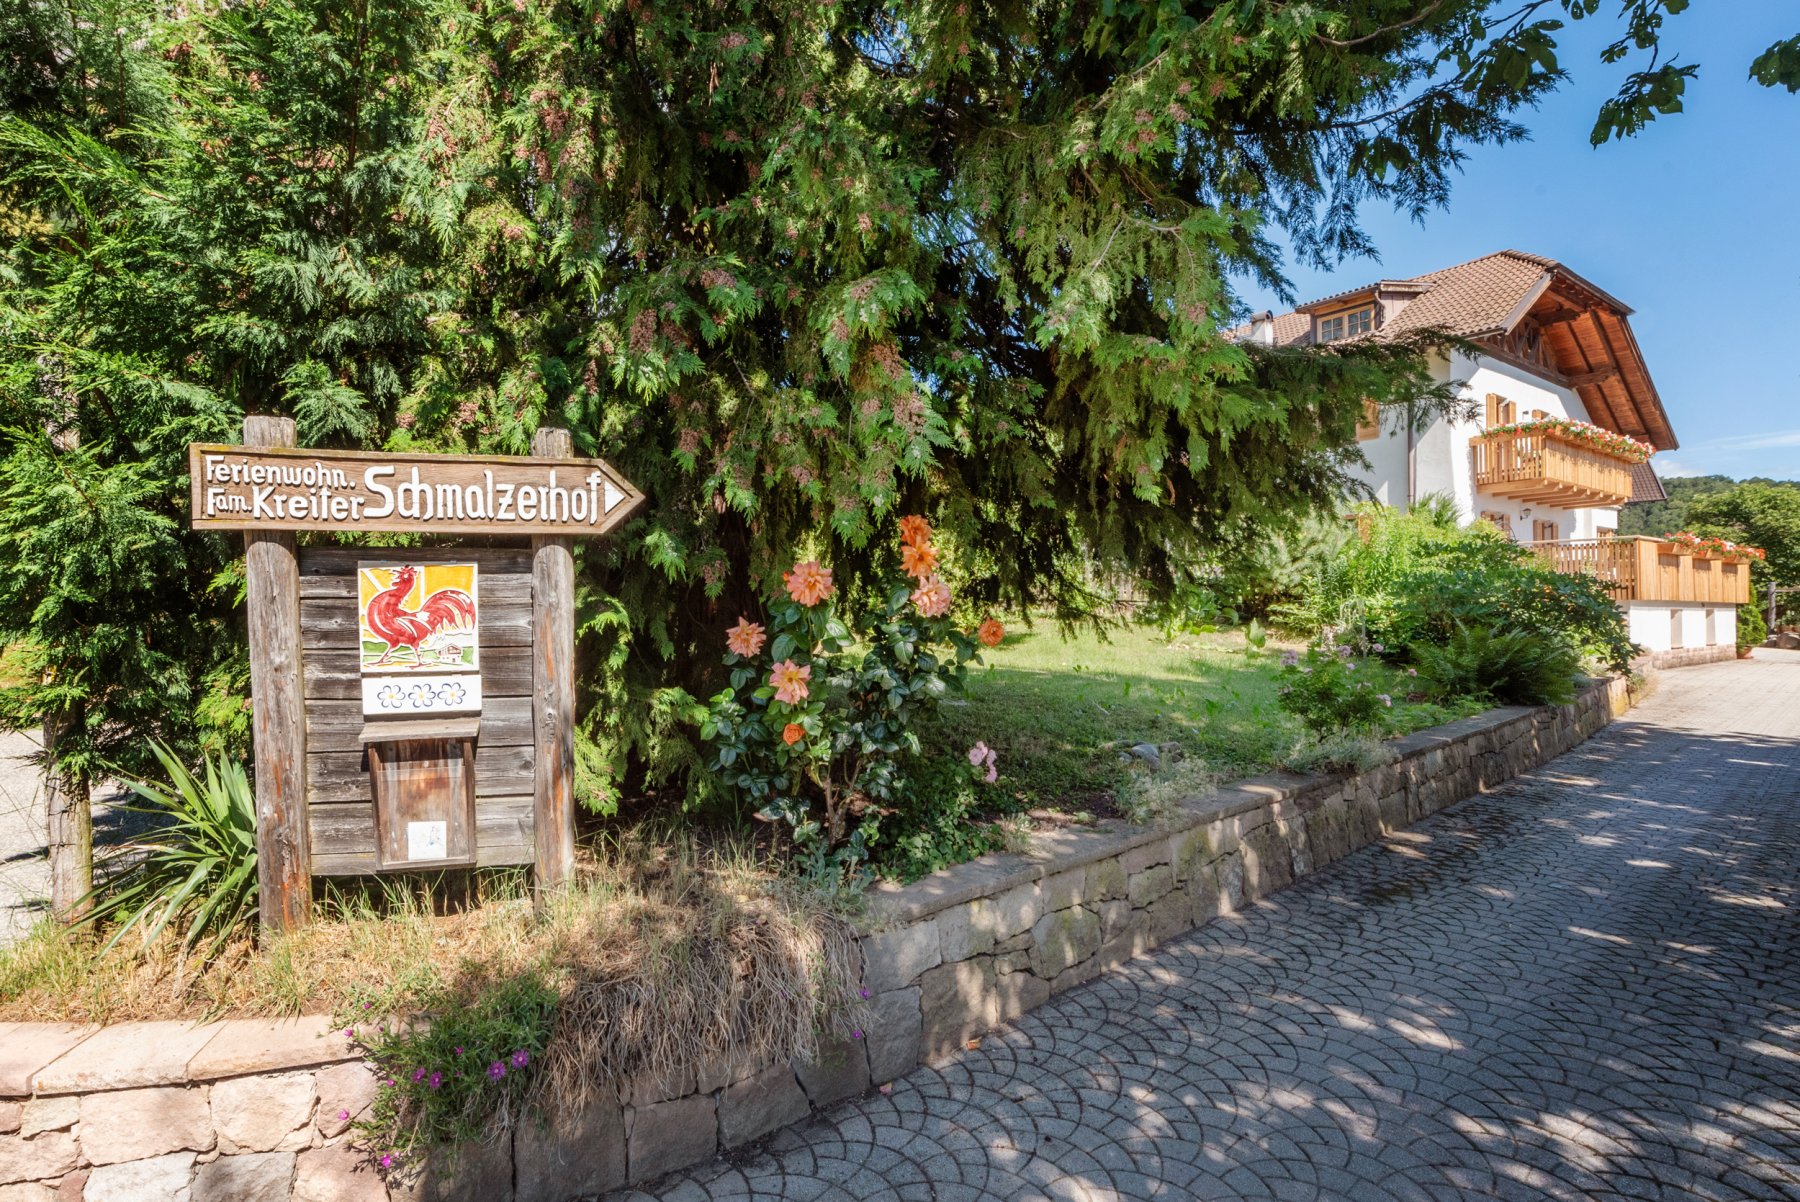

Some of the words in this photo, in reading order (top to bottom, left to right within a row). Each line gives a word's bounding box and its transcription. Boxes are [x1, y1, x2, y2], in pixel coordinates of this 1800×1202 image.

[205, 455, 356, 488] Ferienwohn.
[206, 487, 252, 516] Fam.
[363, 465, 601, 525] Schmalzerhof
